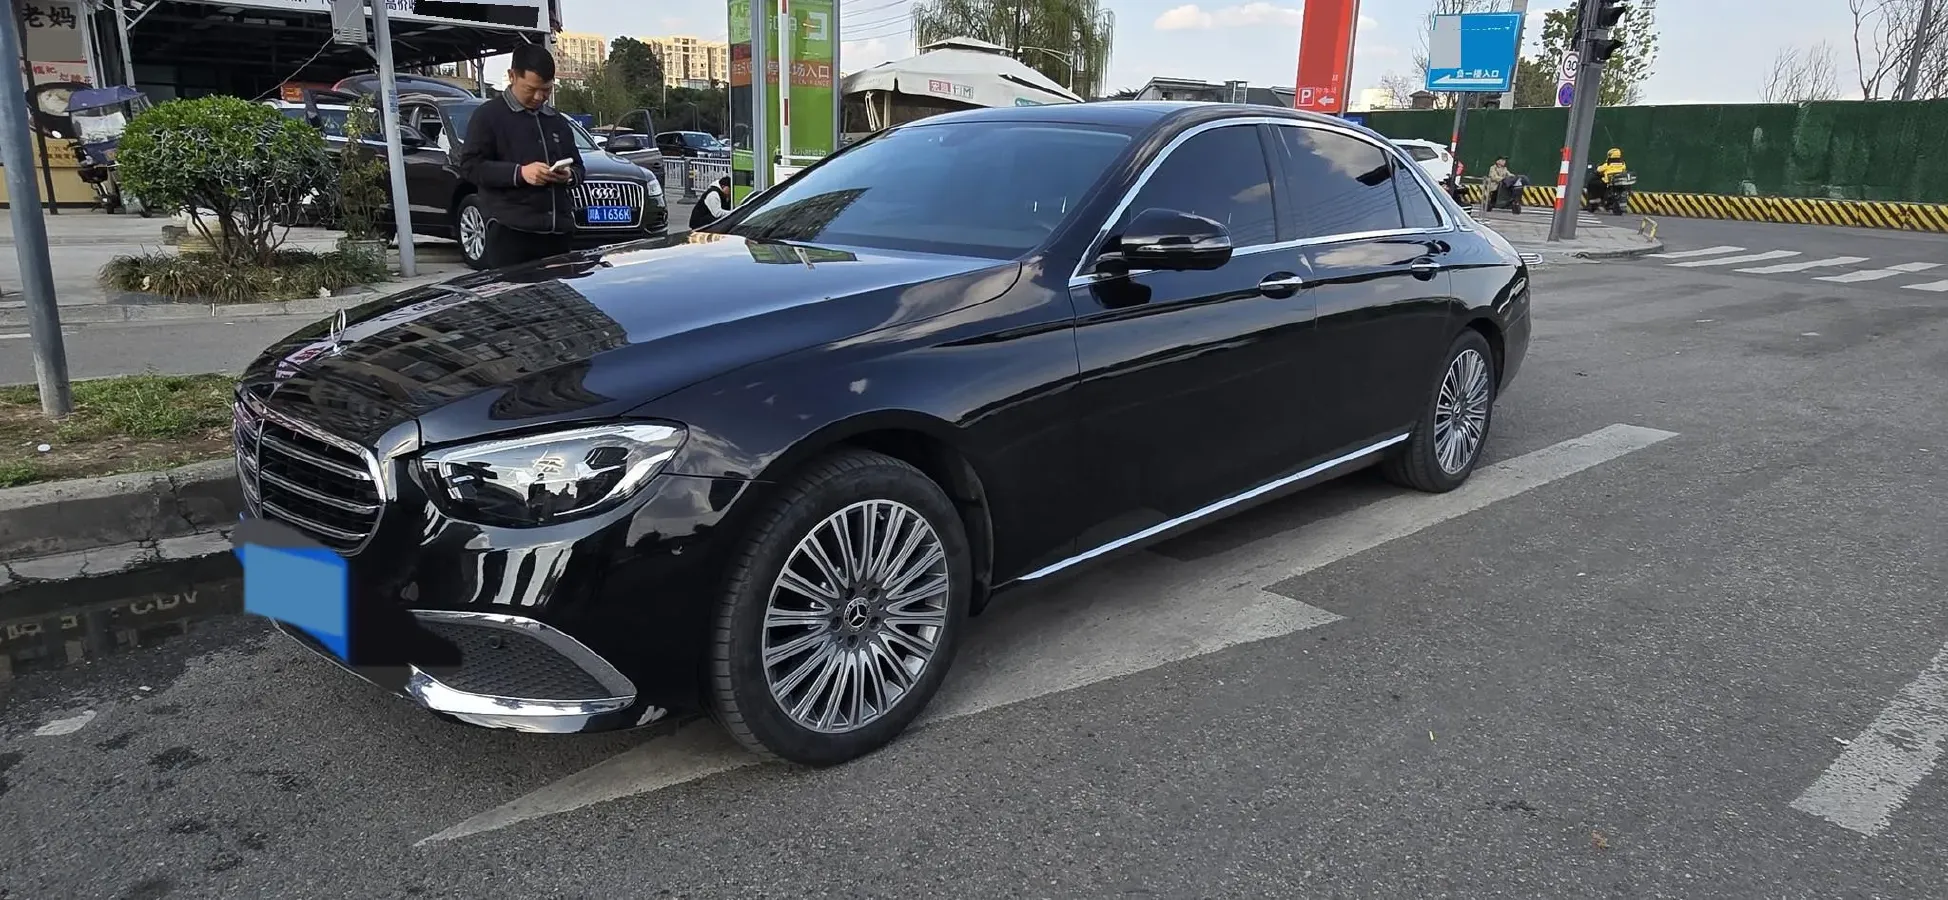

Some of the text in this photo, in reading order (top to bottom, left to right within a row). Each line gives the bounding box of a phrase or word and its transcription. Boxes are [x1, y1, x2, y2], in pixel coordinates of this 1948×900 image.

[22, 3, 77, 29] 老妈
[767, 60, 829, 78] 停场入口
[1566, 60, 1578, 71] 30
[1301, 89, 1312, 104] P
